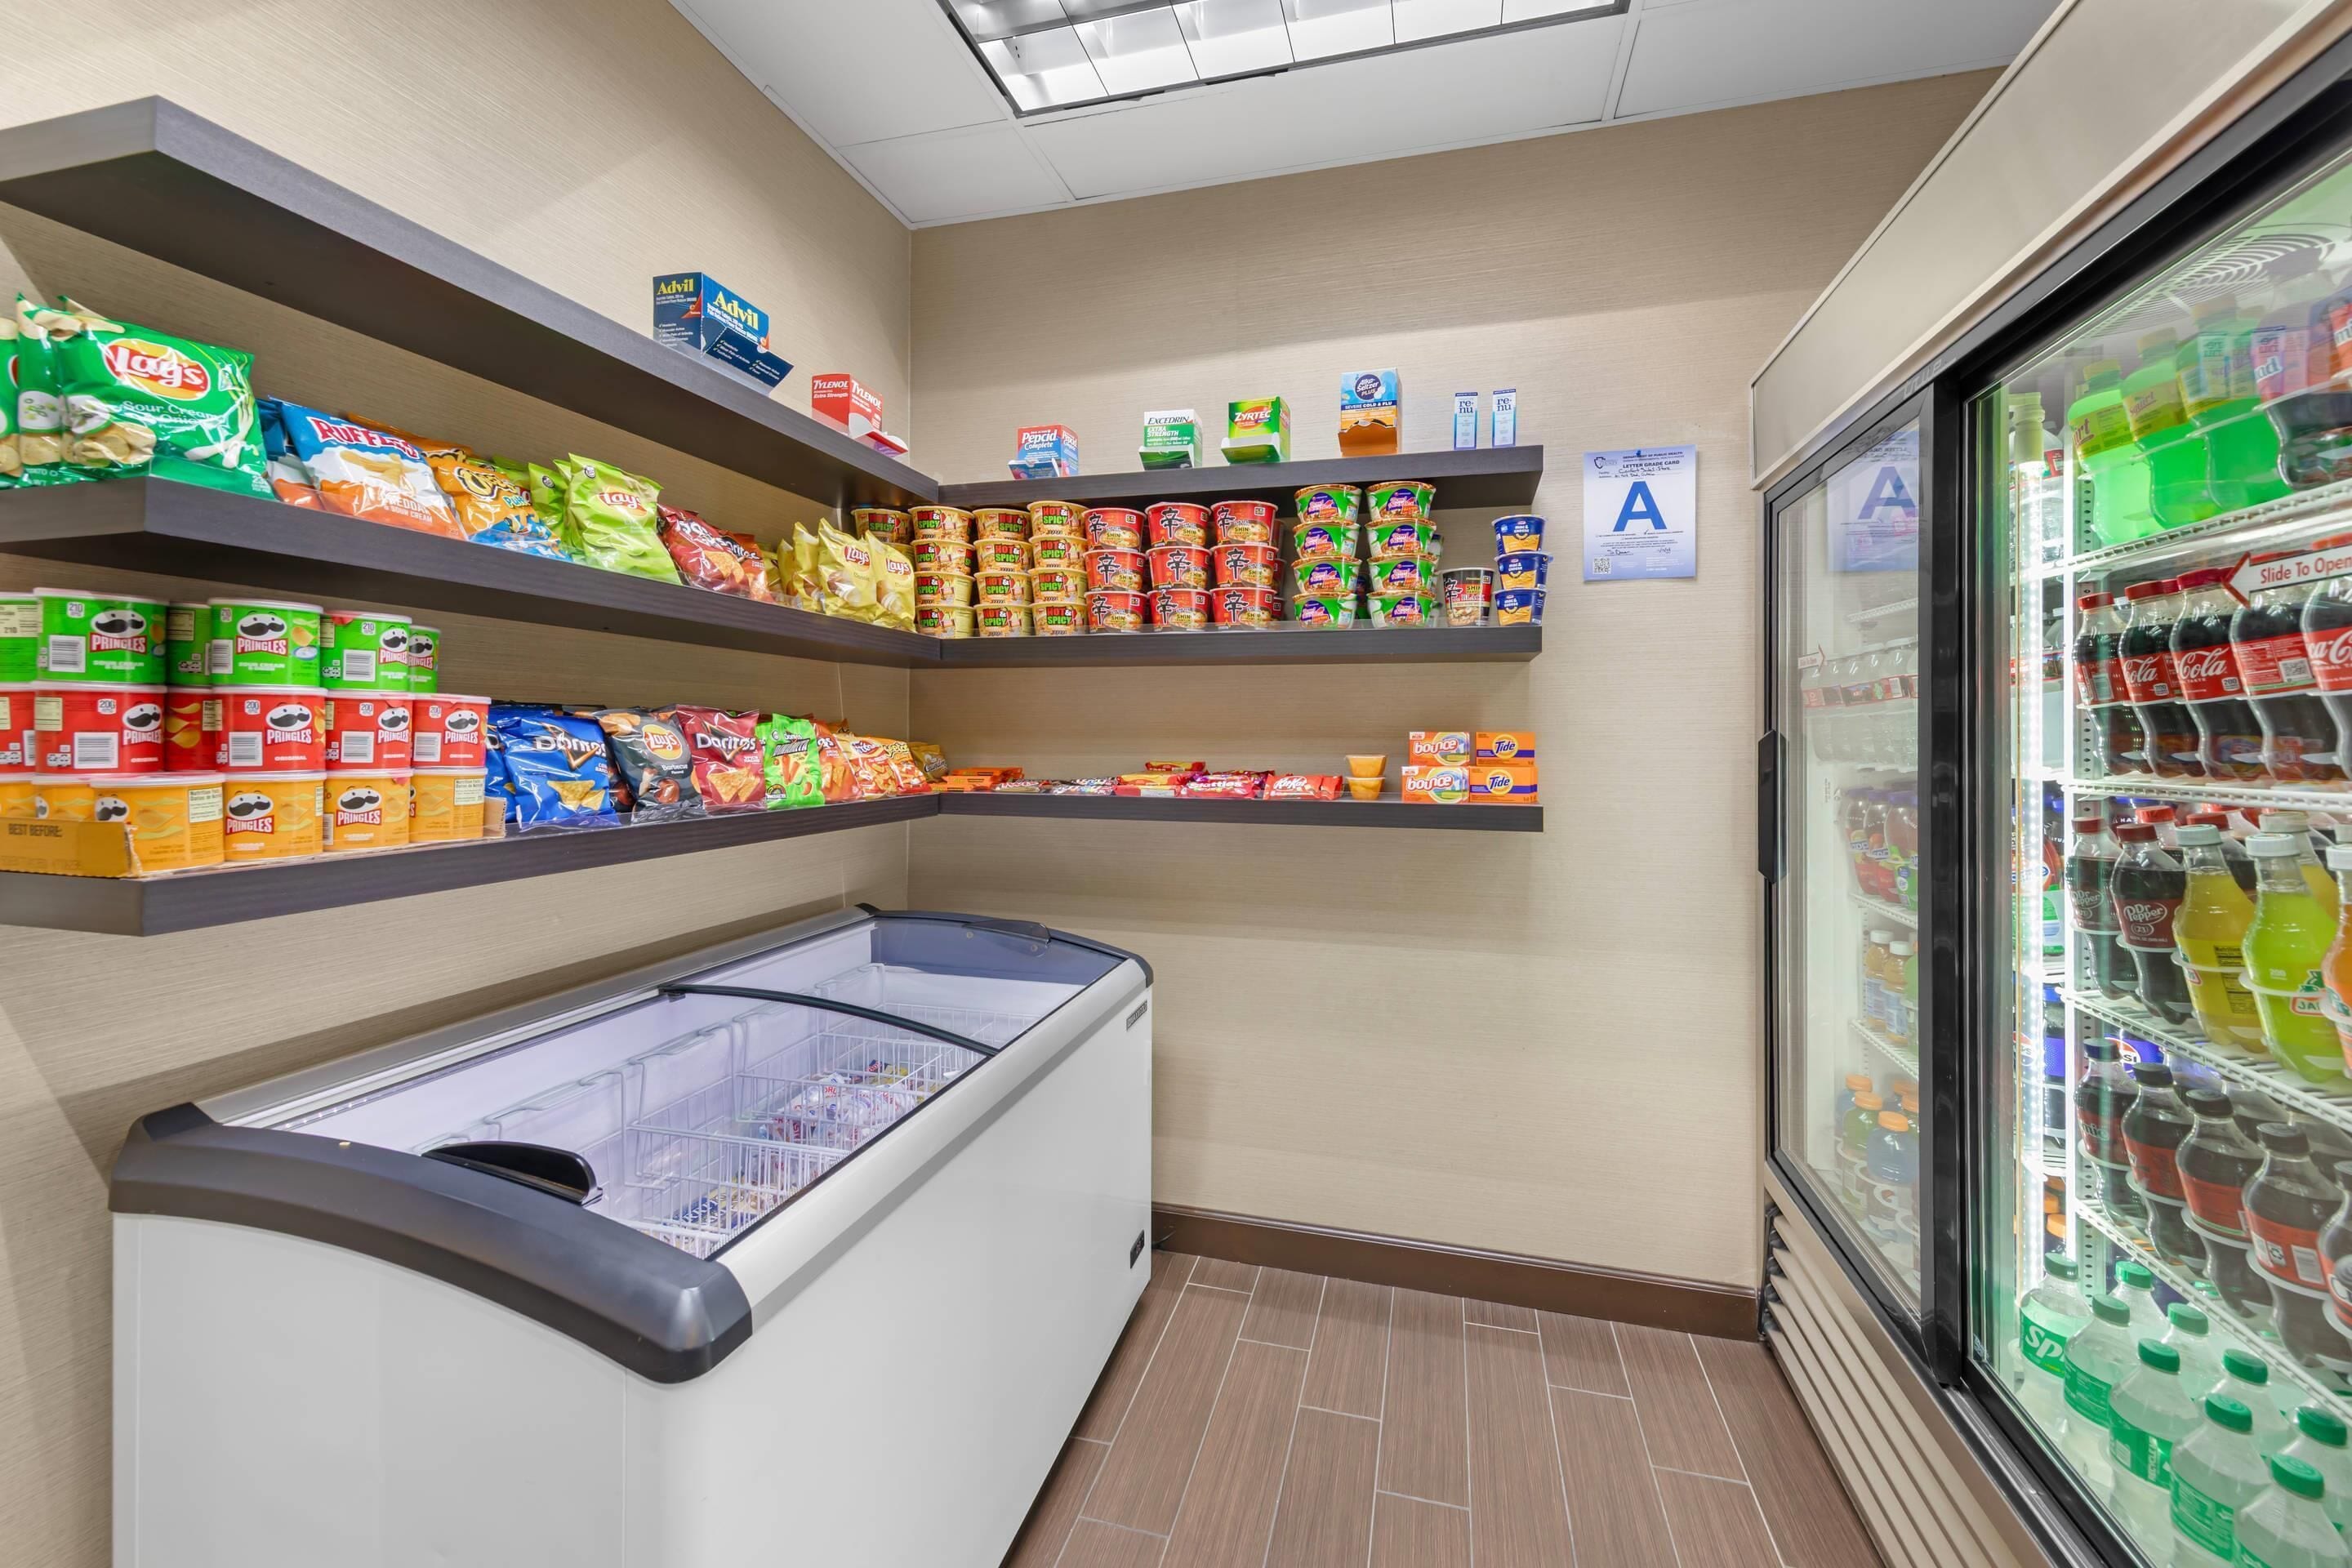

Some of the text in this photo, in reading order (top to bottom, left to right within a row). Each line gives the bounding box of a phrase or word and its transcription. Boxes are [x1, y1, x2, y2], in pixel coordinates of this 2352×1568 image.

[657, 278, 694, 295] Advil
[713, 291, 759, 331] Advil
[114, 346, 203, 387] Lay's
[813, 380, 849, 390] TYLENOL
[1356, 381, 1379, 392] Seltzer
[852, 380, 882, 408] TYLENOL
[122, 401, 164, 412] Sour
[1148, 416, 1189, 425] EXCEDRIN
[1234, 410, 1272, 422] ZYRTEC
[307, 416, 420, 459] RUFFLES
[1022, 430, 1058, 444] Pepcid
[1025, 442, 1054, 450] Complete
[1613, 481, 1668, 532] A
[411, 510, 433, 523] CREAM
[1043, 516, 1067, 524] SPICY
[1160, 507, 1184, 538] 辛
[1218, 507, 1235, 538] 辛
[869, 523, 895, 532] SPICY
[918, 520, 939, 529] SPICY
[999, 523, 1023, 532] SPICY
[1089, 513, 1107, 543] 辛
[916, 553, 935, 562] SPICY
[996, 553, 1020, 563] SPICY
[1041, 550, 1066, 559] SPICY
[1098, 554, 1120, 584] 辛
[1167, 550, 1192, 581] 辛
[1227, 548, 1250, 580] 辛
[2261, 555, 2352, 584] Slide To Open
[918, 585, 939, 595] SPICY
[986, 585, 1010, 595] SPICY
[1040, 582, 1062, 591] SPICY
[1092, 595, 1111, 626] 辛
[1156, 594, 1178, 625] 辛
[1225, 591, 1248, 622] 辛
[920, 617, 938, 627] SPICY
[985, 618, 1007, 627] SPICY
[1048, 616, 1071, 625] SPICY
[92, 634, 146, 653] PRINGLES
[238, 638, 286, 654] PRINGLES
[409, 657, 433, 669] RINGLES
[2179, 647, 2230, 679] Cola
[123, 729, 161, 745] PRINGLES
[267, 729, 311, 744] PRINGLES
[378, 730, 408, 743] PRINGLES
[444, 731, 478, 744] PRINGLES
[648, 732, 679, 751] Lay's
[696, 733, 756, 749] Doritos
[1414, 739, 1458, 754] bounce
[1495, 741, 1515, 754] Tide
[1406, 776, 1453, 791] bounce
[1489, 776, 1510, 790] Tide
[338, 810, 381, 825] PRINGLES
[8, 823, 27, 835] BEST
[226, 818, 273, 833] PRINGLES
[2124, 906, 2164, 922] Pepper
[2135, 904, 2151, 912] Dr
